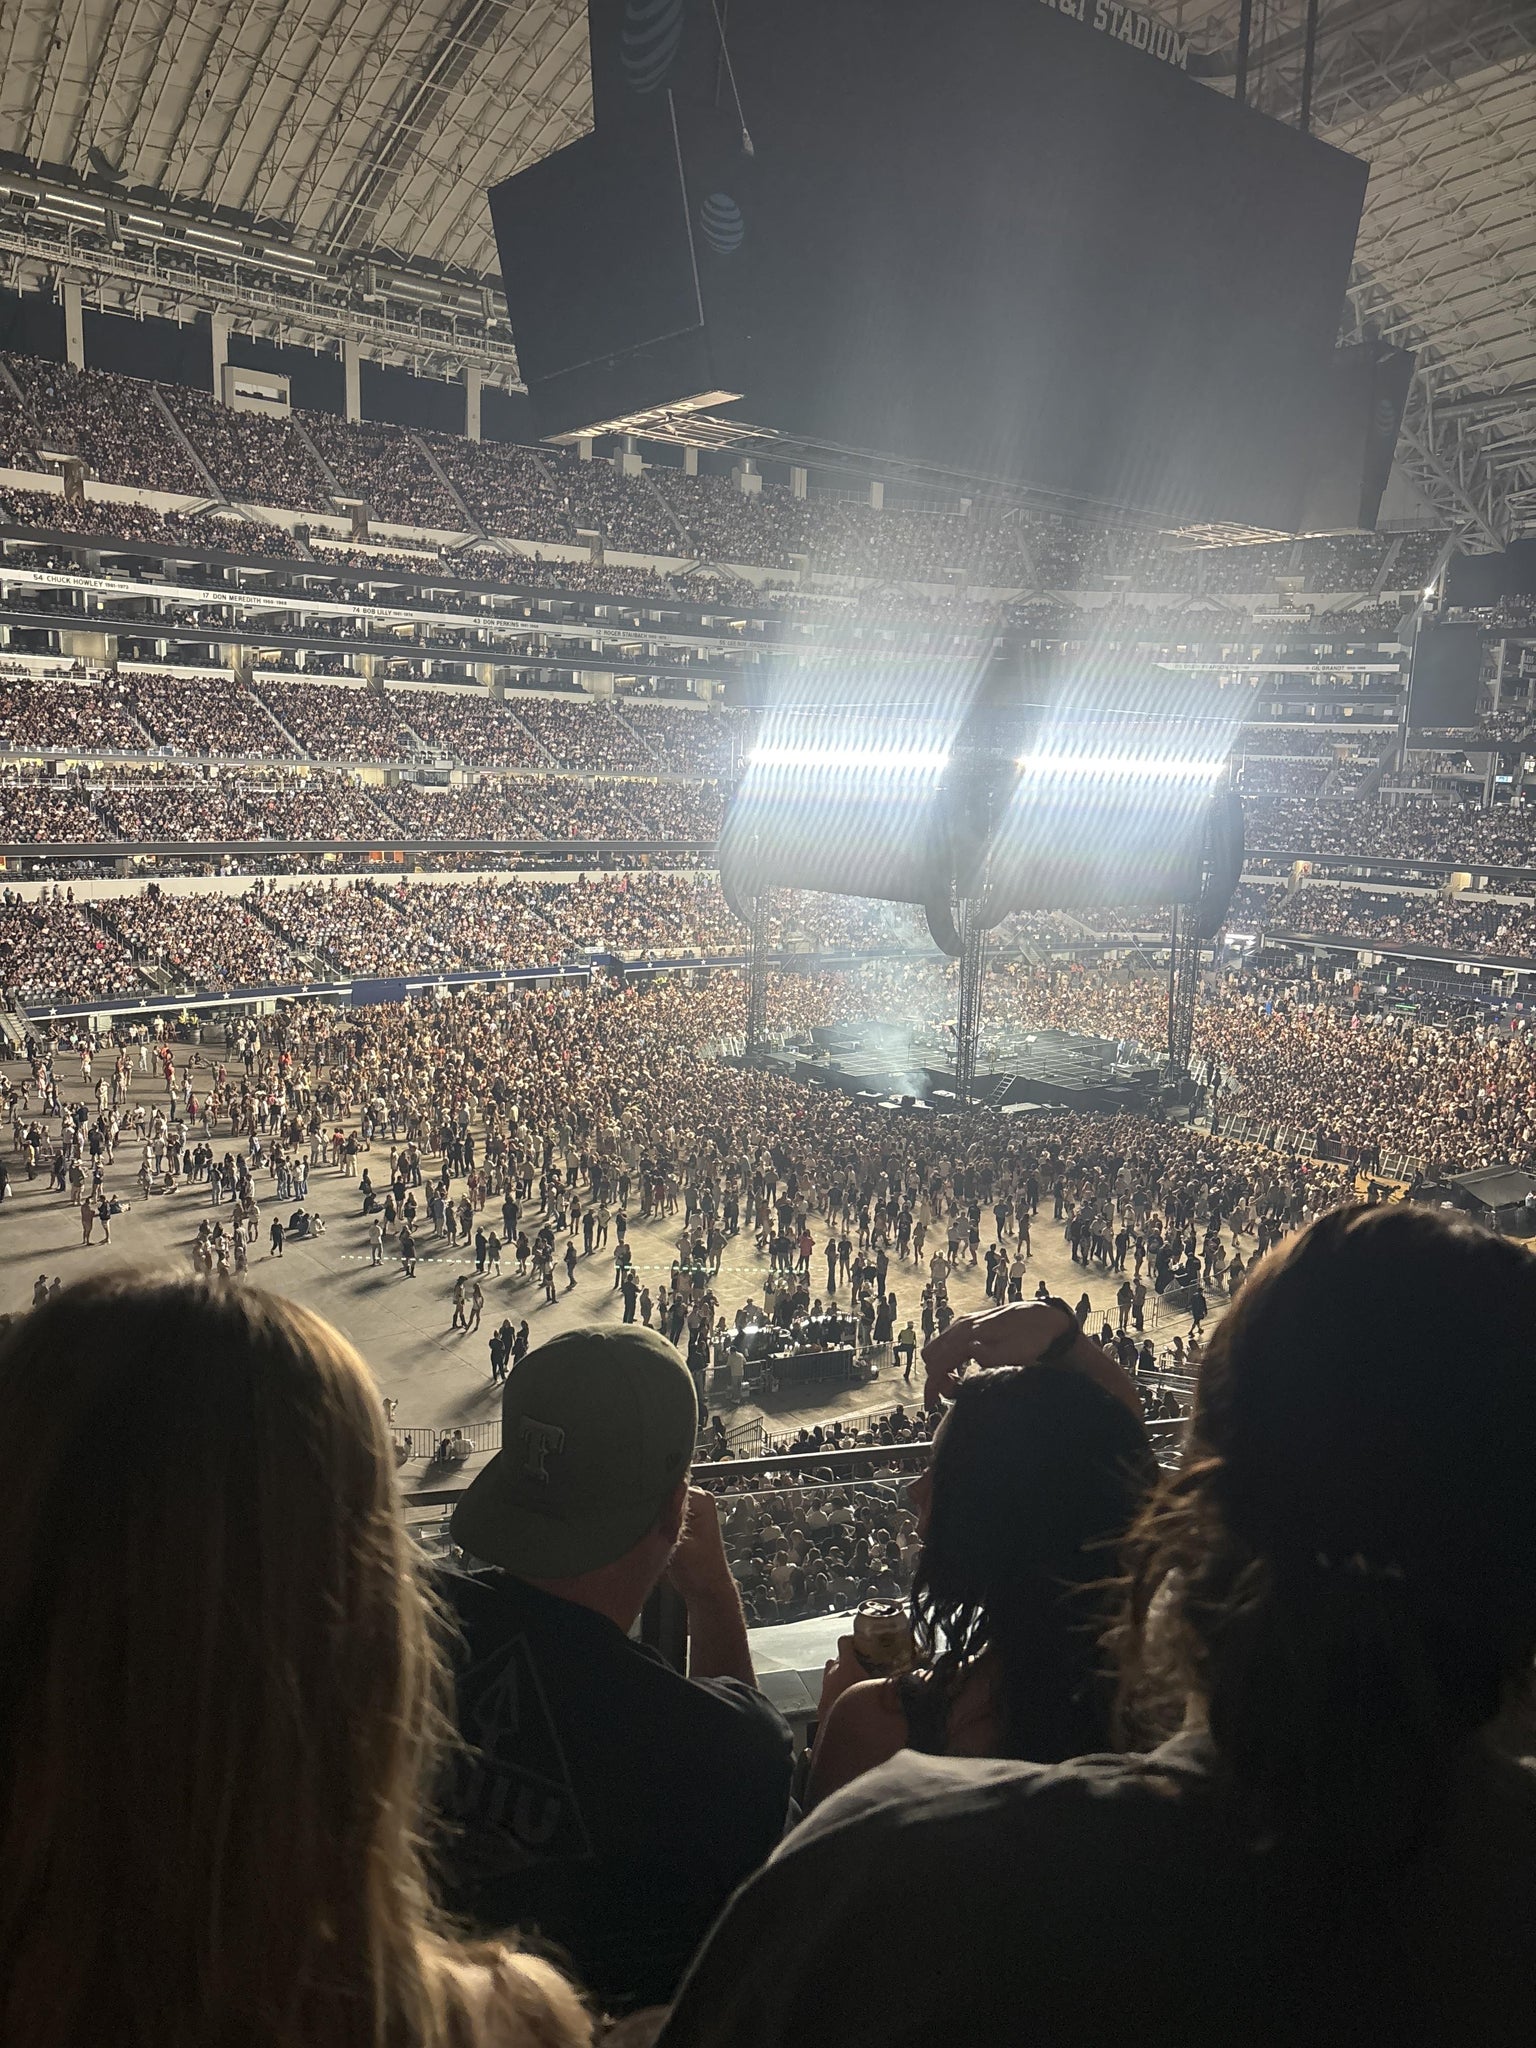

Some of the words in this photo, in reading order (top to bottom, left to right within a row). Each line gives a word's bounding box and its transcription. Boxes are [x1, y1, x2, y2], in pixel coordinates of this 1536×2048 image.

[1040, 0, 1084, 21] &T
[1093, 0, 1191, 71] STADIUM
[33, 573, 43, 581] 54
[46, 575, 72, 584] CHUCK
[73, 577, 103, 587] HOWLEY
[229, 595, 262, 604] MEREDITH
[496, 620, 519, 628] PERKINS
[621, 631, 647, 639] STAUBACH
